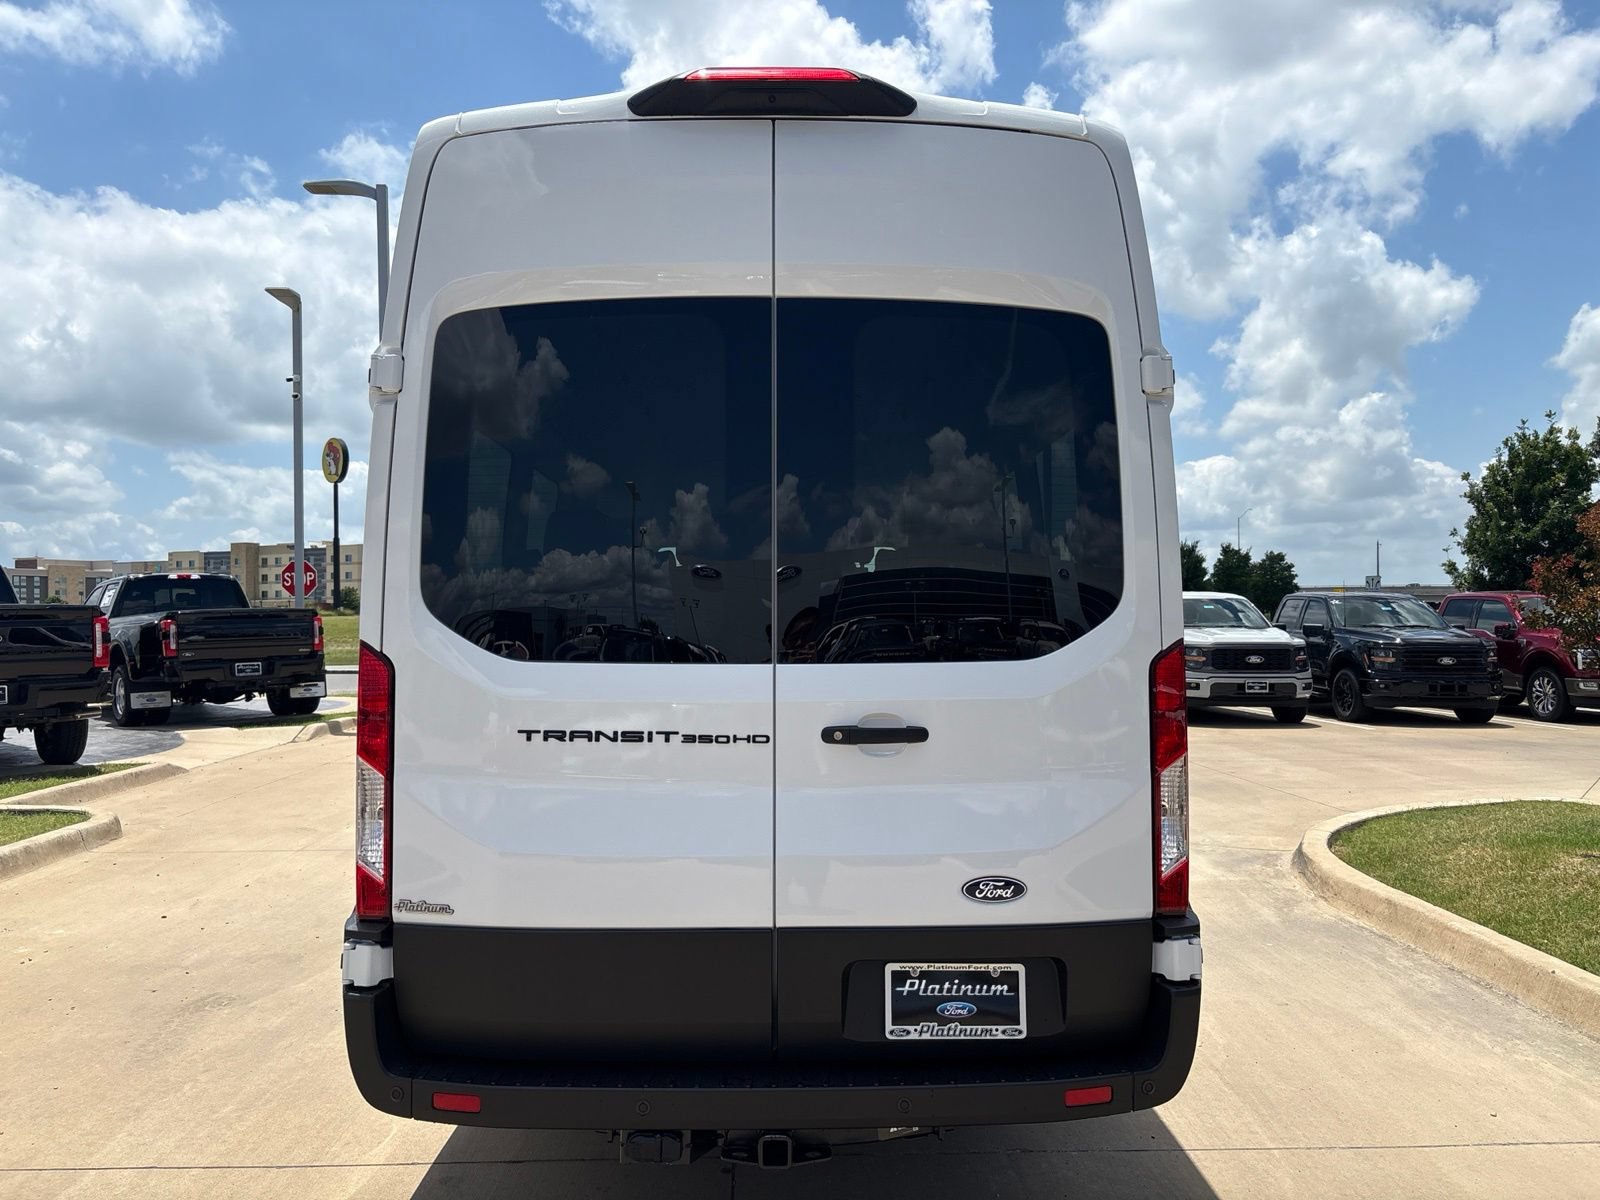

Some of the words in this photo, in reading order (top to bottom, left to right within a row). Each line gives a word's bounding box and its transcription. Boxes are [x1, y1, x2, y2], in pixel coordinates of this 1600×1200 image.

[283, 572, 315, 586] STP
[517, 729, 680, 744] TRANSIT
[975, 880, 1015, 898] Ford
[394, 899, 454, 915] Platinum
[899, 963, 1012, 971] www.PlatinumFord.com
[895, 979, 1015, 996] Platinum
[944, 1004, 969, 1015] Ford
[918, 1023, 999, 1038] Platinum
